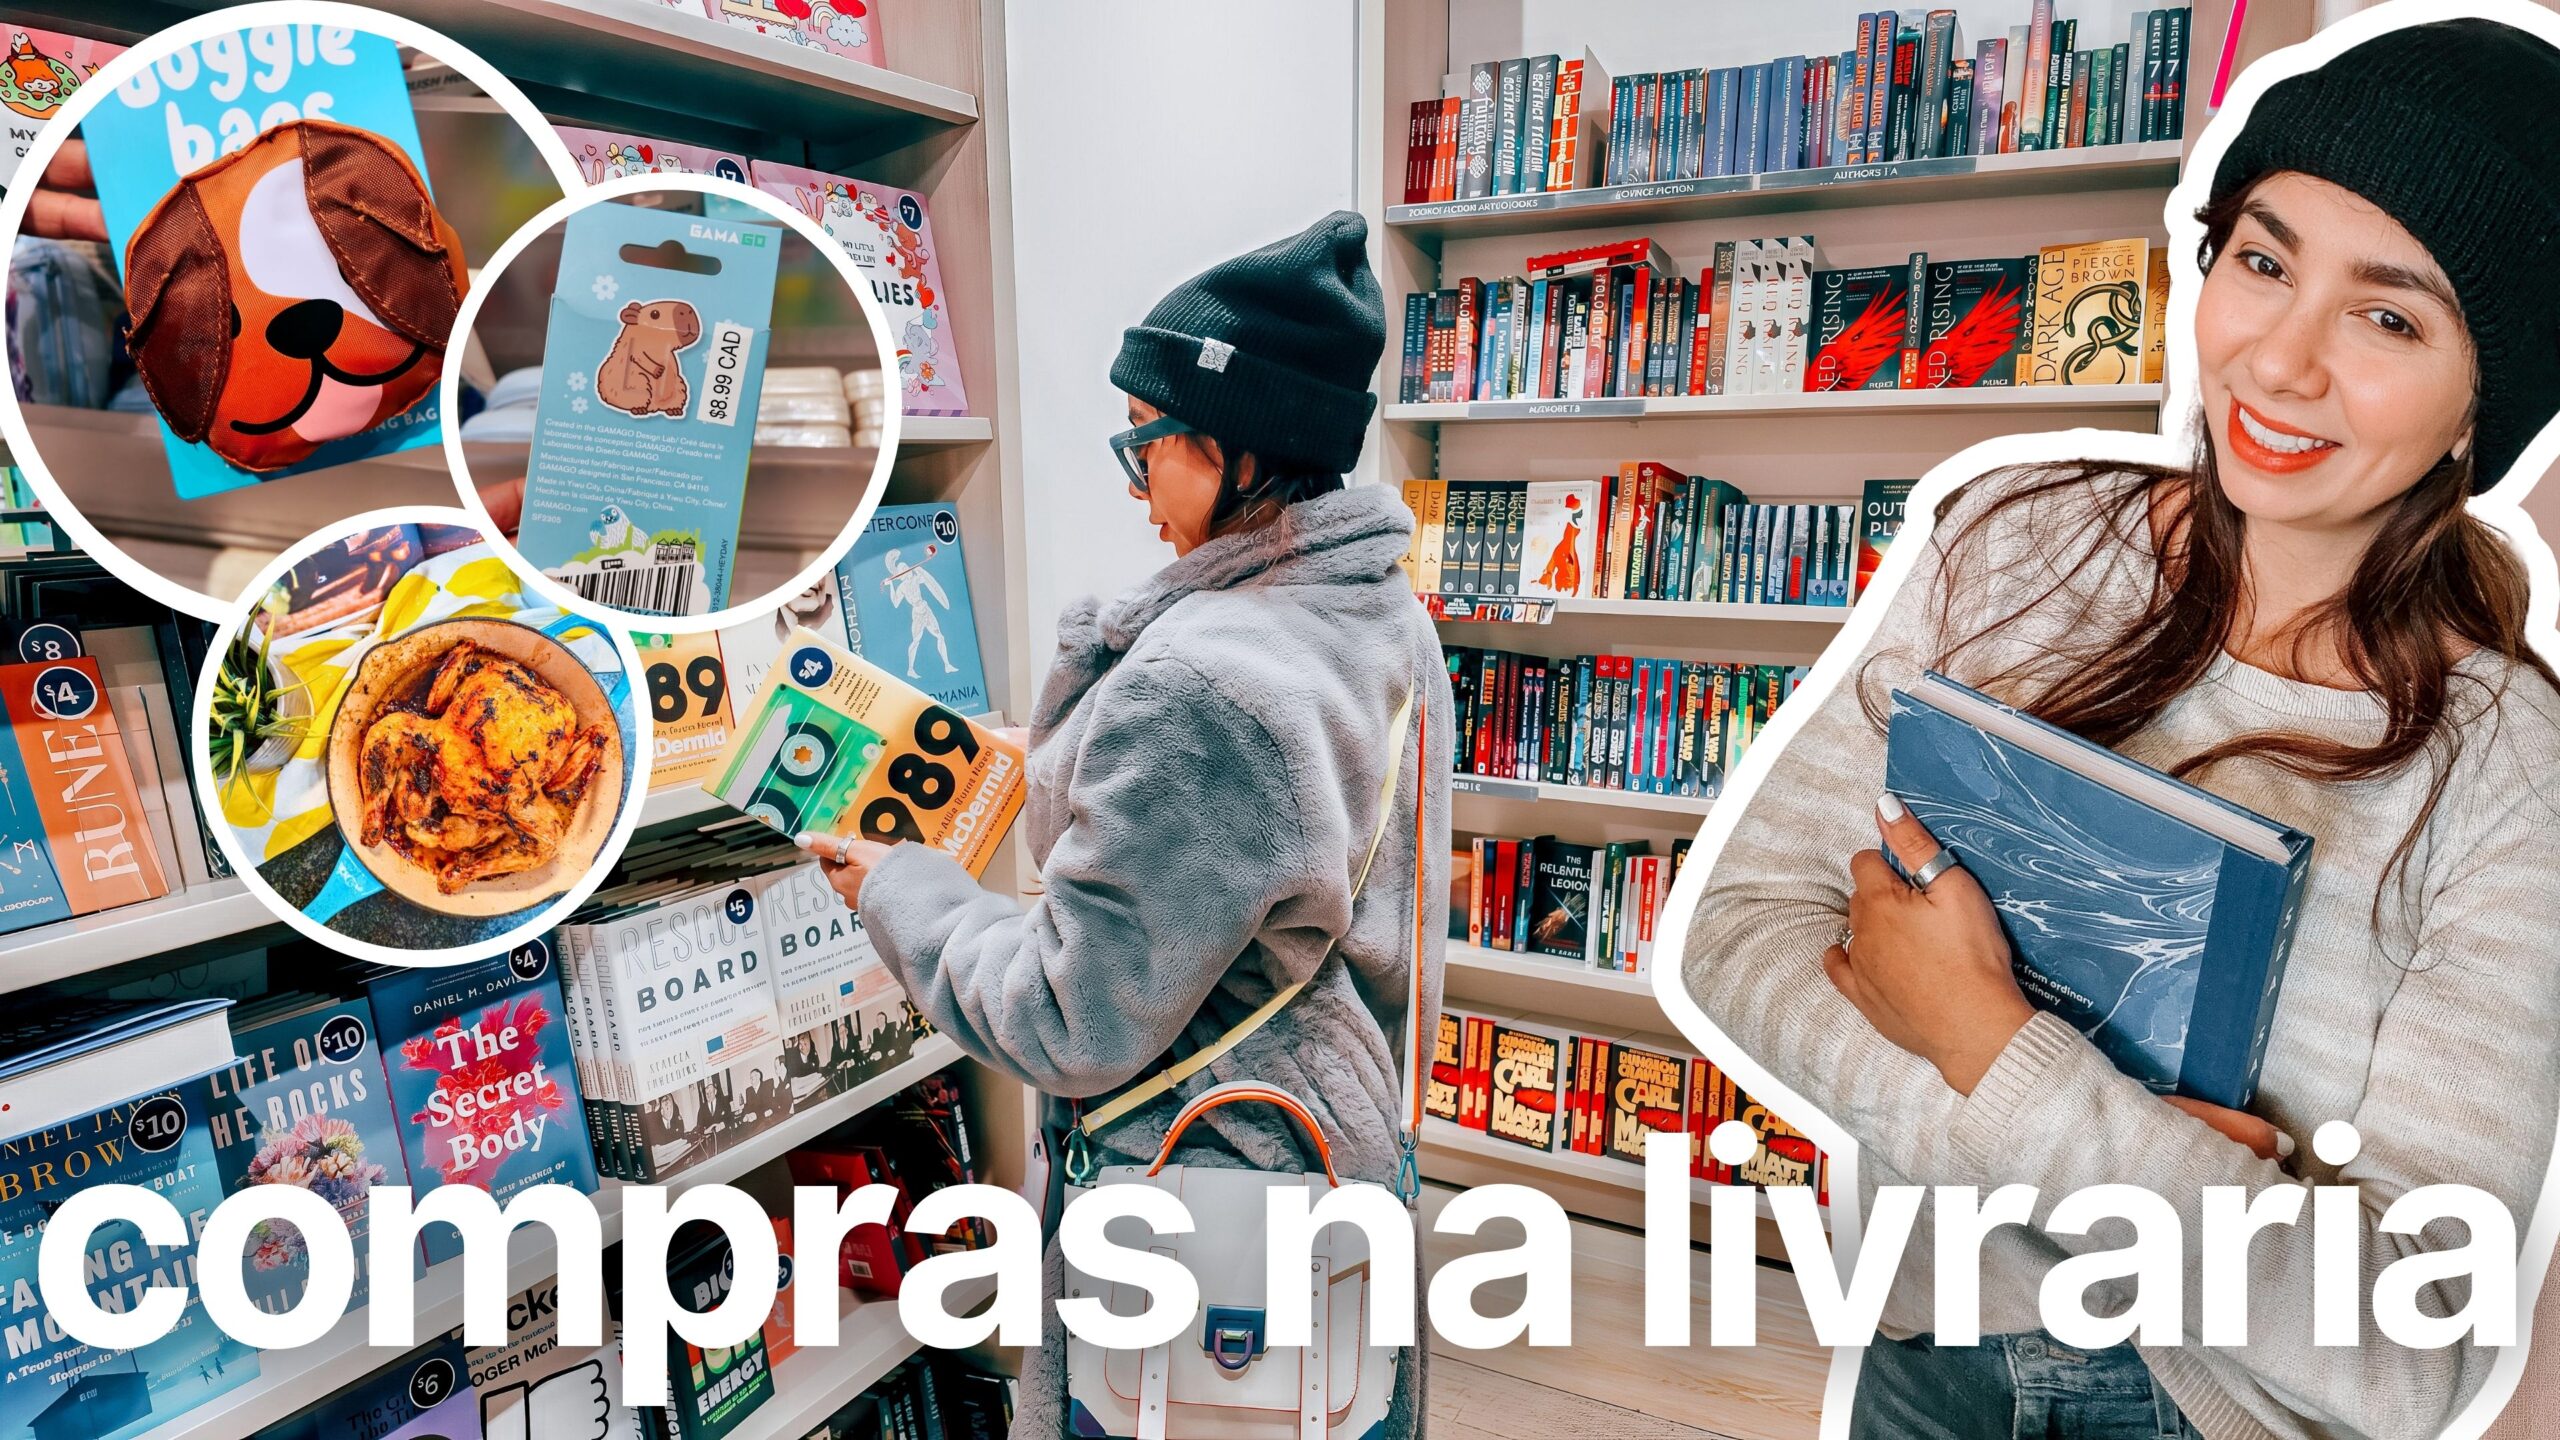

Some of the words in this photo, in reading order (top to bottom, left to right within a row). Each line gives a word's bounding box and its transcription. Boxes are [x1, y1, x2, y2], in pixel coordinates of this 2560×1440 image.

[2149, 60, 2162, 79] 7
[2167, 59, 2180, 78] 7
[690, 224, 767, 248] GAMAGO
[2071, 266, 2137, 284] BROWN
[2072, 253, 2137, 271] PIERCE
[1819, 273, 1846, 346] RISING
[1929, 265, 1956, 343] RISING
[718, 330, 741, 370] CAD
[2033, 310, 2072, 385] DARK
[1816, 354, 1841, 392] RED
[1926, 351, 1953, 390] RED
[709, 374, 733, 420] $8.99
[404, 407, 438, 426] BAG
[542, 439, 583, 451] Laboratorio
[584, 443, 594, 452] de
[545, 418, 575, 430] Created
[576, 423, 583, 431] in
[584, 423, 596, 433] the
[597, 425, 634, 437] GAMAGO
[636, 431, 661, 442] Design
[699, 440, 717, 449] dans
[583, 434, 593, 442] de
[594, 435, 634, 448] conception
[676, 447, 702, 458] Creado
[536, 475, 557, 486] Made
[558, 478, 566, 486] in
[567, 480, 584, 489] Yiwu
[538, 462, 577, 474] GAMAGO
[578, 467, 612, 480] designed
[613, 472, 619, 480] in
[620, 472, 635, 482] San
[673, 480, 686, 489] CA
[540, 452, 590, 466] Manufactured
[691, 473, 704, 482] por
[533, 499, 589, 514] GAMAGO.com
[535, 486, 559, 497] Hecho
[560, 489, 570, 498] en
[571, 490, 578, 498] la
[579, 492, 604, 503] ciudad
[604, 494, 615, 504] de
[616, 496, 634, 507] Yiwu
[31, 638, 63, 662] $8
[798, 658, 824, 680] $4
[44, 679, 80, 706] $4
[645, 655, 727, 724] 89
[860, 704, 981, 847] 989
[515, 949, 539, 969] $4
[636, 949, 758, 1014] BOARD
[2023, 964, 2049, 985] from
[2049, 980, 2095, 1009] ordinary
[413, 989, 463, 1016] DANIEL
[321, 1025, 362, 1055] $10
[436, 1021, 521, 1071] The
[209, 1046, 281, 1100] LIFE
[1492, 1058, 1555, 1095] CARL
[265, 1067, 368, 1133] ROCKS
[426, 1061, 551, 1129] Secret
[1491, 1088, 1553, 1131] MATT
[1614, 1078, 1681, 1114] CARL
[135, 1110, 181, 1141] $10
[446, 1109, 549, 1174] Body
[0, 1135, 130, 1202] BROW
[154, 1164, 197, 1192] BOAT
[417, 1372, 440, 1396] $6
[696, 1348, 764, 1417] ENERGY
